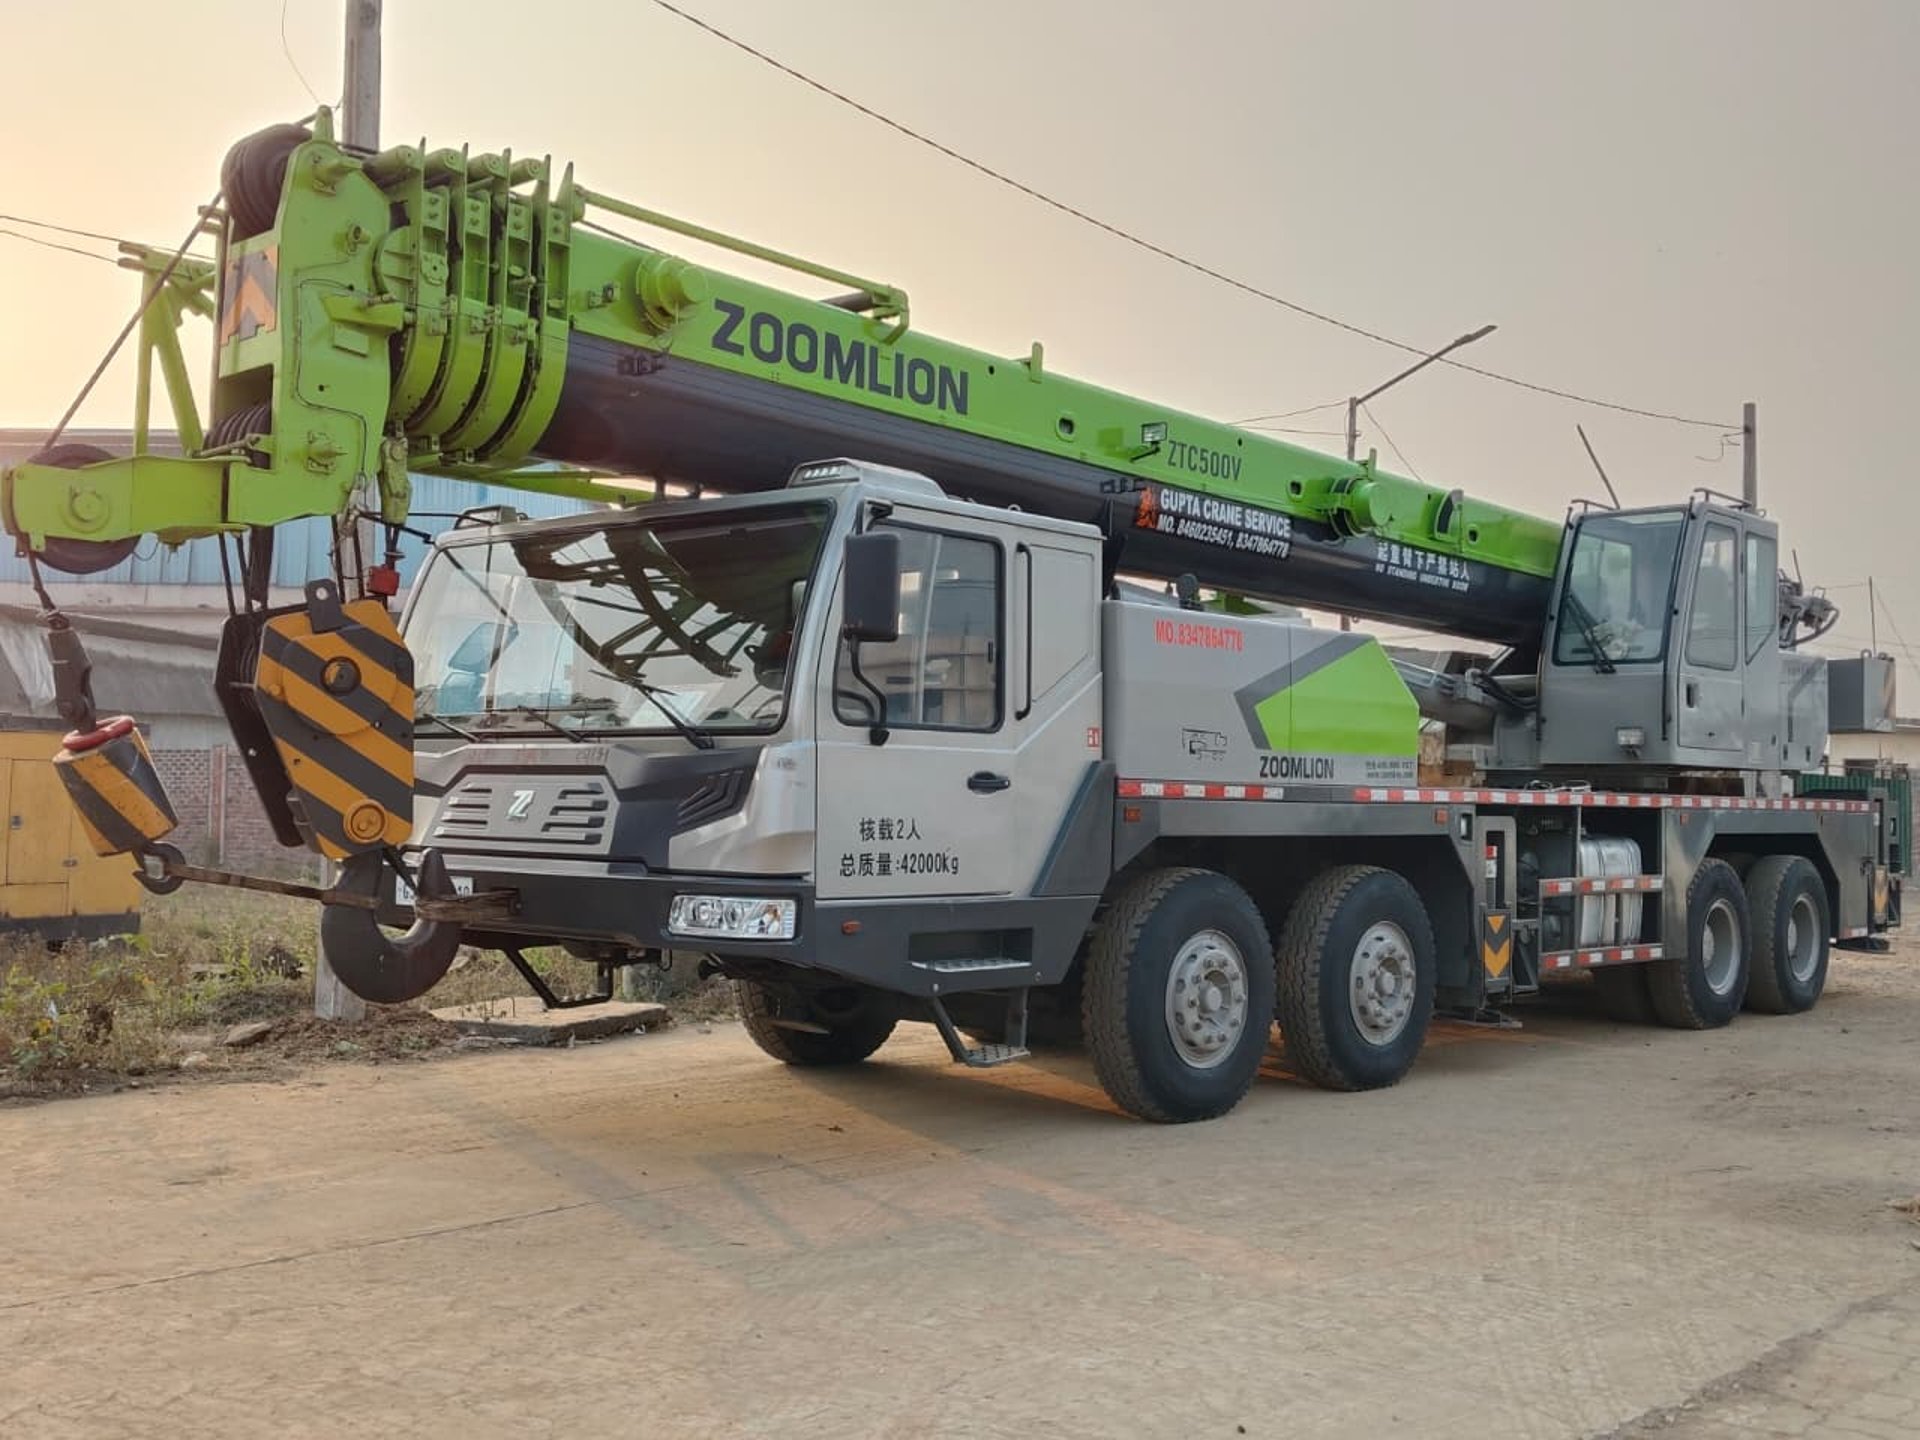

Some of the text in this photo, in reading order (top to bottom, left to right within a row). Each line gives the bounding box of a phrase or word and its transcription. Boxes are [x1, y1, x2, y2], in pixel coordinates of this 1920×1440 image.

[711, 298, 969, 416] ZOOMLION
[1167, 440, 1242, 481] ZTC500V
[1159, 488, 1292, 538] GUPTA CRANE SERVICE
[1259, 755, 1335, 779] ZOOMLION
[859, 816, 922, 841] 核载2人
